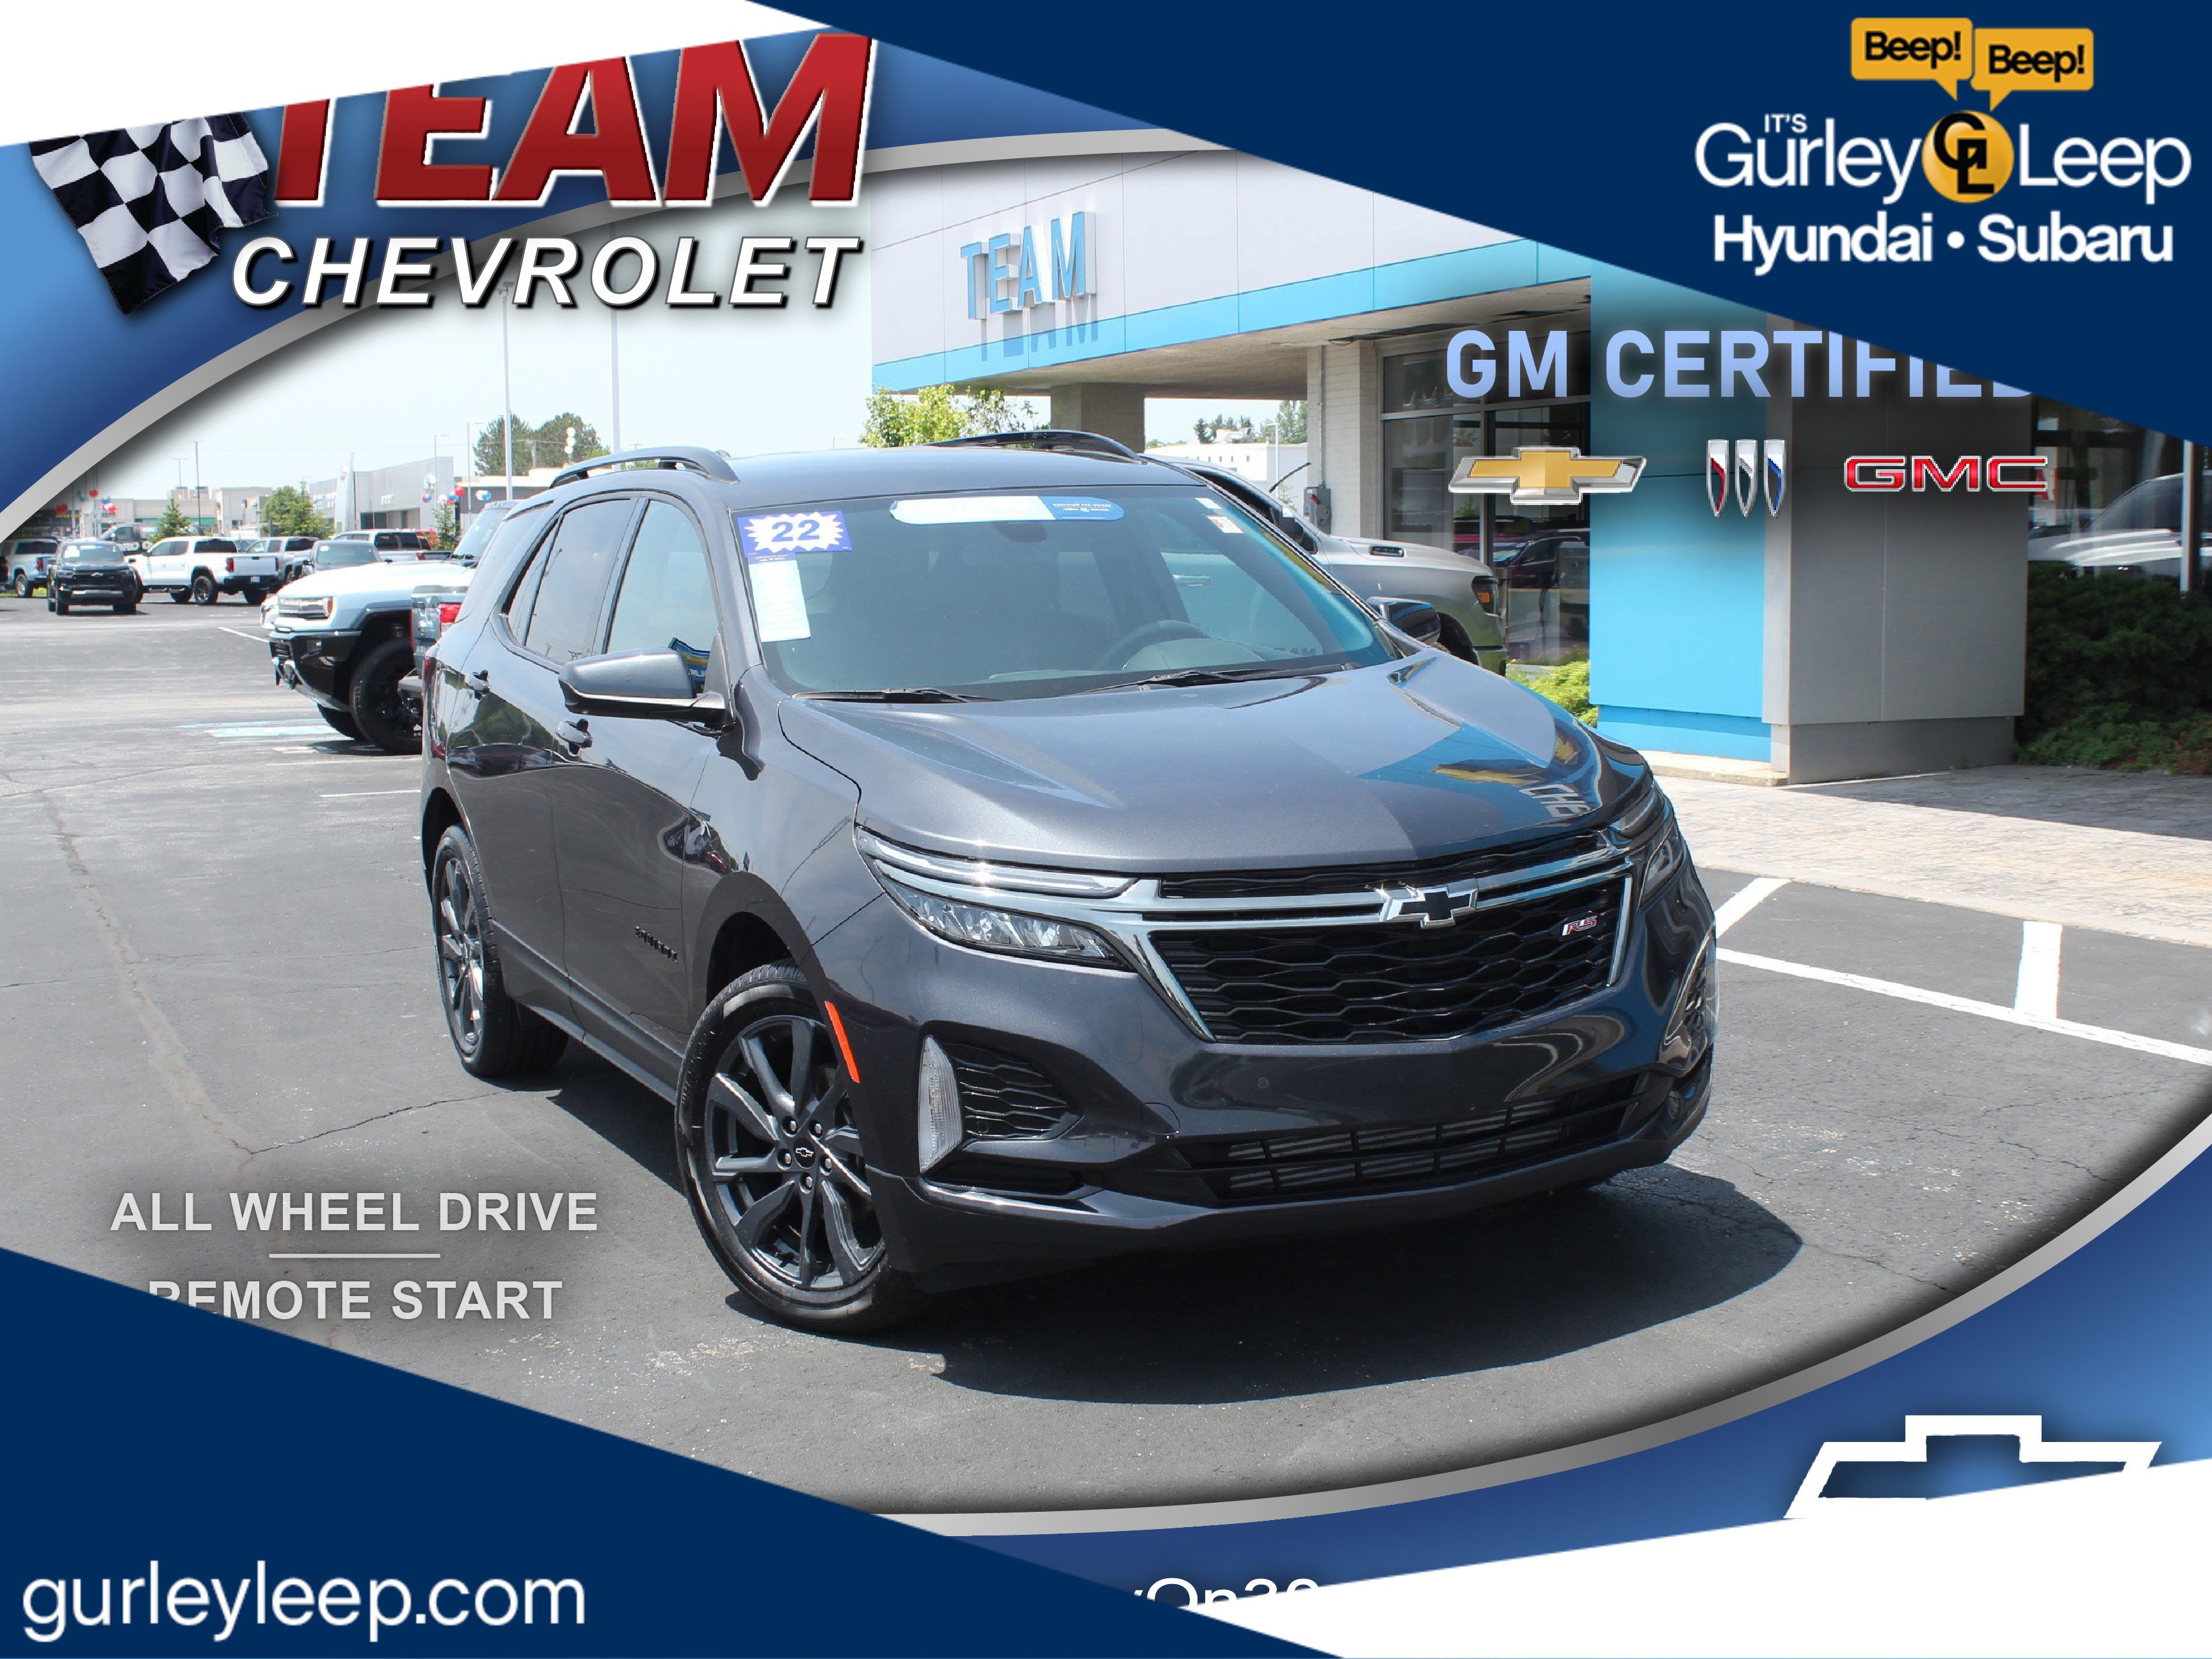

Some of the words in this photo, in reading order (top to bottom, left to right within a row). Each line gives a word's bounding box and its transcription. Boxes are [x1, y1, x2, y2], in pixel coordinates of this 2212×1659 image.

[960, 211, 1096, 320] TEAM
[771, 519, 820, 543] 22
[1562, 915, 1598, 936] RS
